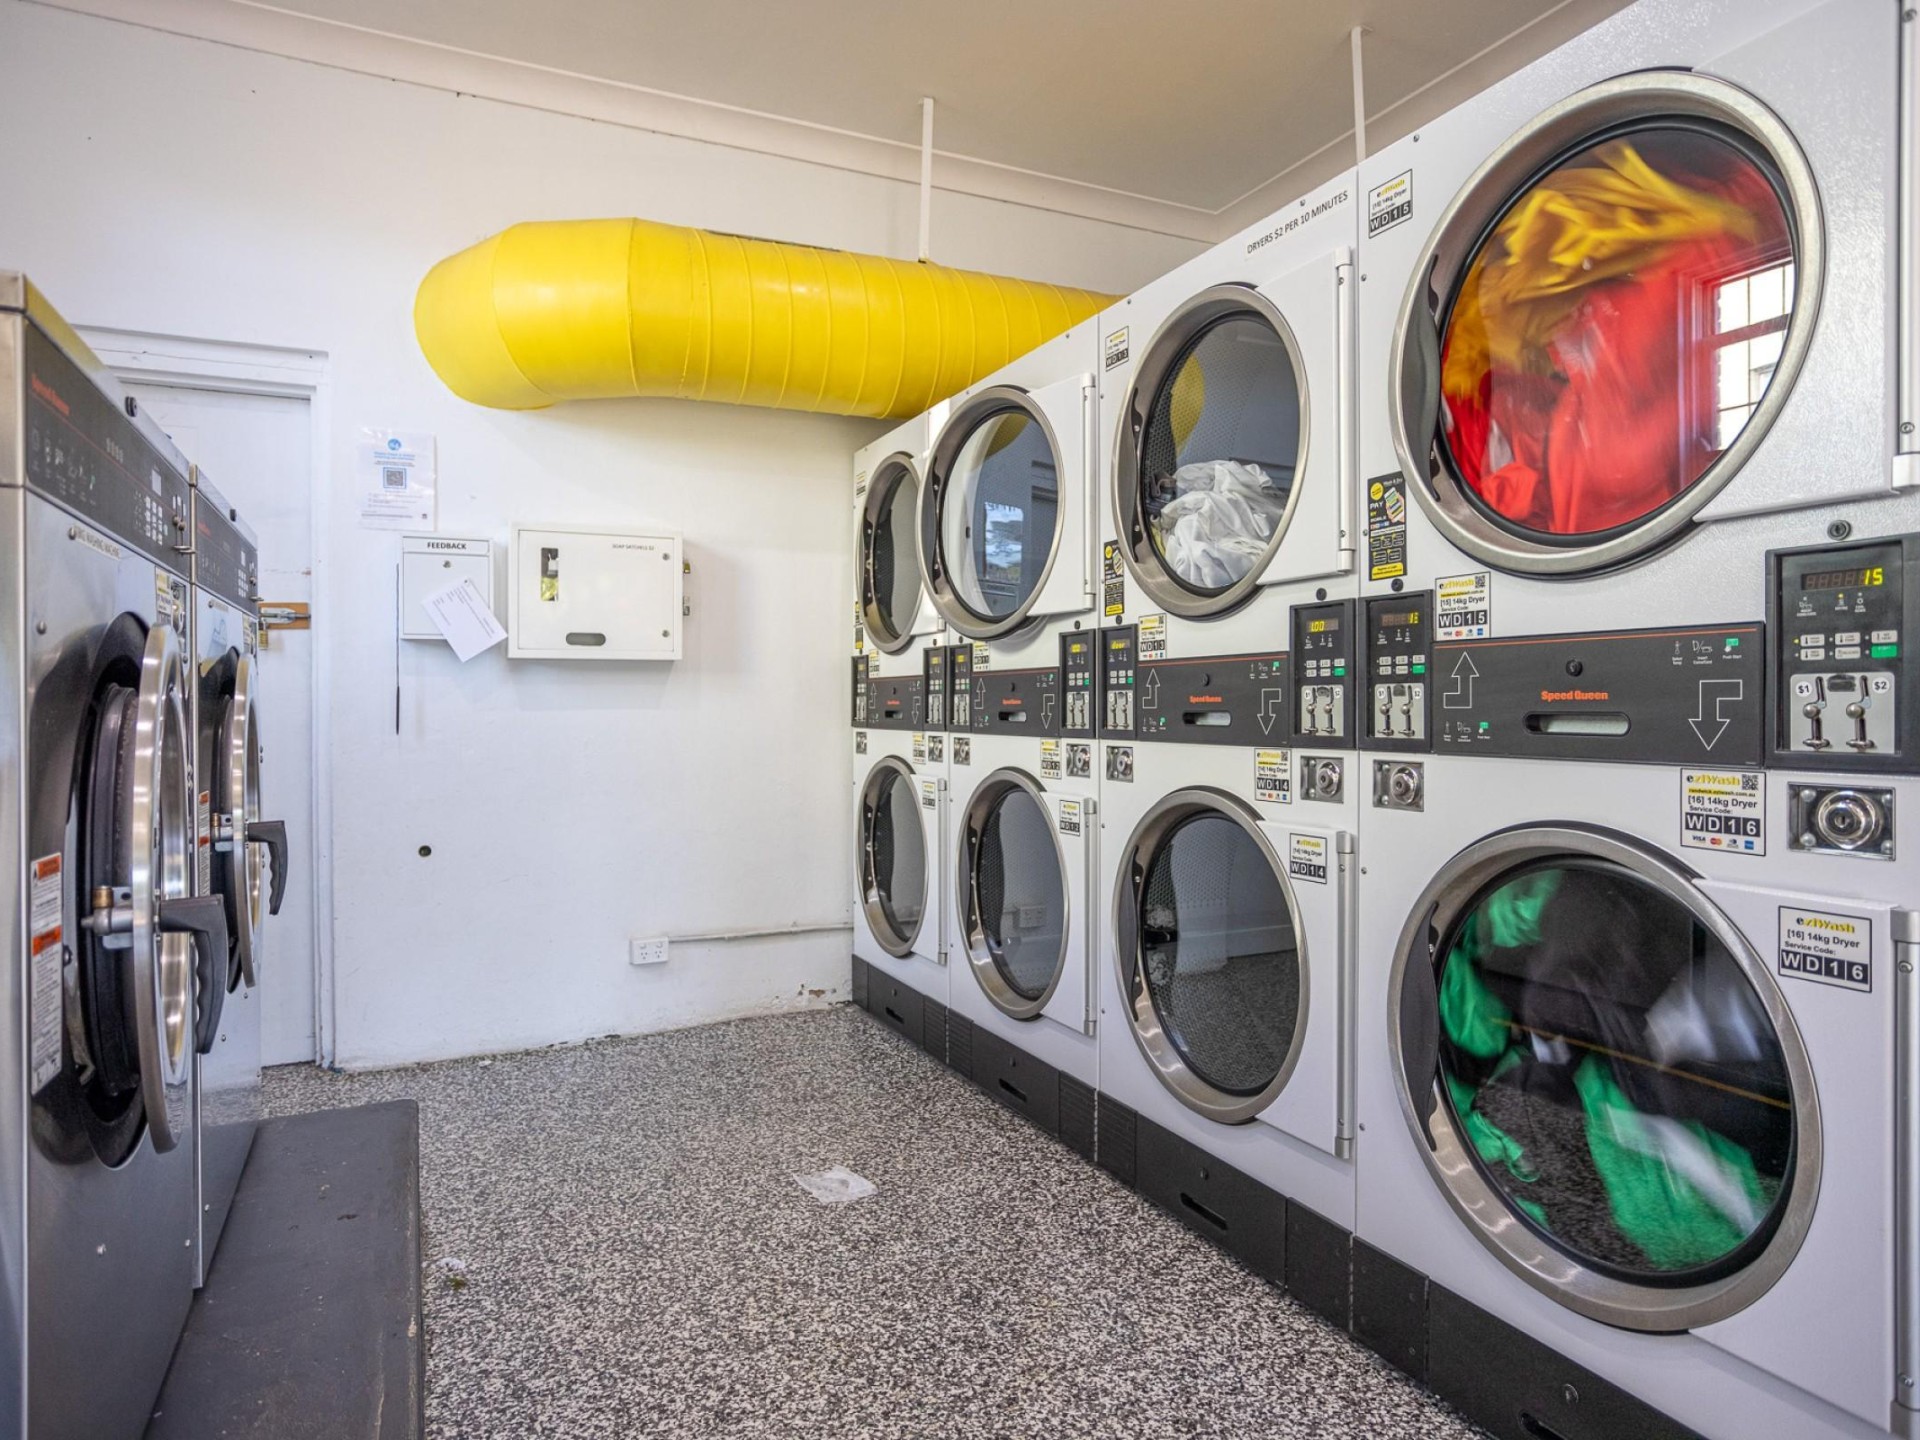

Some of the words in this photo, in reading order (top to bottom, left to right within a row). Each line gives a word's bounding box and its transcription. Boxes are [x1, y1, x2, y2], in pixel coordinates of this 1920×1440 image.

[1246, 232, 1274, 255] DRYERS
[1274, 226, 1284, 240] $2
[1284, 218, 1300, 235] PER
[1300, 211, 1311, 226] 10
[1311, 189, 1349, 219] MINUTES
[1370, 500, 1384, 510] PAY
[427, 542, 467, 550] FEEDBACK
[1453, 597, 1468, 605] 14kg
[1468, 596, 1486, 604] Dryer
[1798, 684, 1810, 694] $1
[1873, 681, 1888, 691] $2
[1541, 690, 1574, 703] Speed
[1574, 690, 1609, 701] Queen
[1688, 795, 1705, 806] [16]
[1707, 796, 1729, 808] 14kg
[1731, 798, 1758, 809] Dryer
[1689, 805, 1713, 813] Service
[1787, 929, 1805, 941] [16]
[1807, 932, 1830, 945] 14kg
[1832, 936, 1861, 949] Dryer
[1784, 940, 1812, 951] Service
[1813, 945, 1837, 955] Code:
